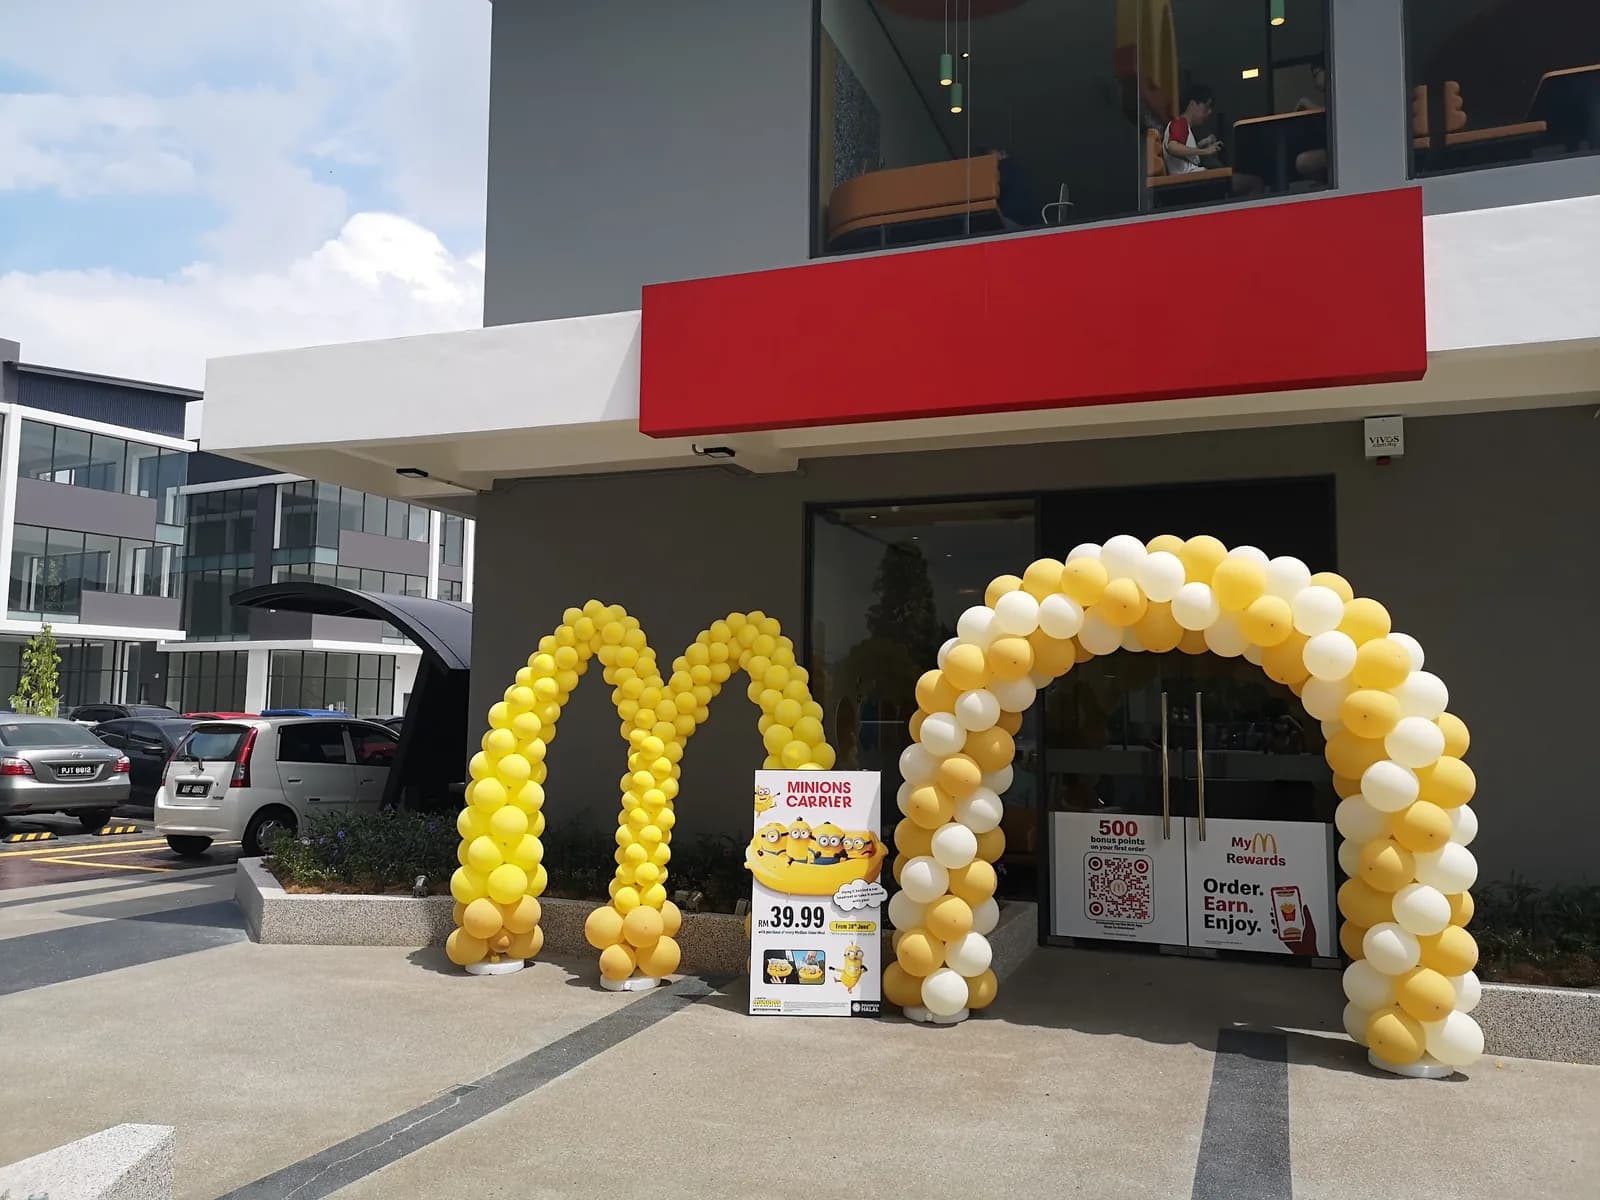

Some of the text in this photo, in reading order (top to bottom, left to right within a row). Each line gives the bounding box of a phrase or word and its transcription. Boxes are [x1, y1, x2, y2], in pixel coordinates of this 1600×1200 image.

[787, 781, 851, 794] MINIONS
[786, 795, 852, 808] CARRIER
[1099, 820, 1138, 836] 500
[1117, 837, 1145, 845] points
[1231, 836, 1252, 851] My
[1226, 853, 1286, 867] Rewards
[1203, 878, 1264, 896] Order.
[1204, 895, 1254, 914] Earn.
[758, 905, 825, 928] RM 39.99
[1204, 913, 1262, 936] Enjoy.
